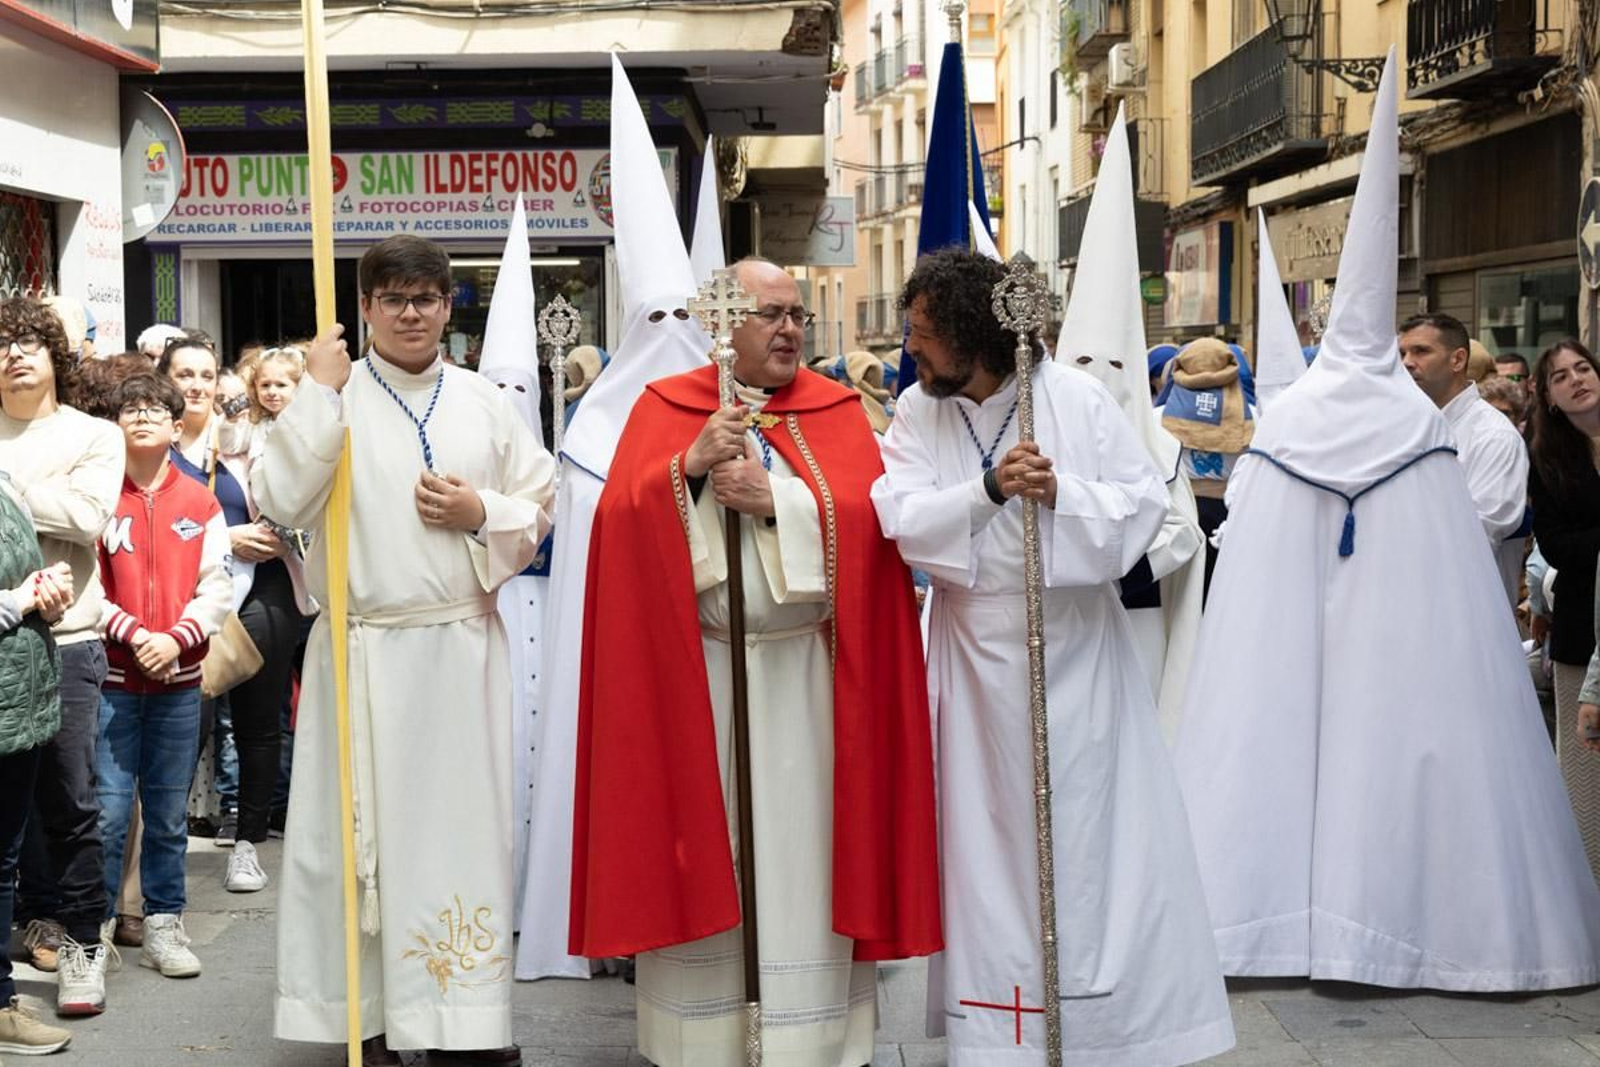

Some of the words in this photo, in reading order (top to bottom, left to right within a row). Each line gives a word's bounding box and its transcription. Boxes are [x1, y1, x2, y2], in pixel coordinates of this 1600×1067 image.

[180, 156, 229, 198] UTO
[360, 153, 414, 197] SAN
[424, 150, 578, 194] ILDEFONSO
[174, 202, 284, 217] LOCUTORIO
[359, 199, 479, 215] FOTOCOPIAS
[157, 222, 237, 234] RECARGAR
[250, 221, 312, 233] LIBERAR
[399, 220, 409, 231] Y
[413, 218, 509, 231] ACCESORIOS
